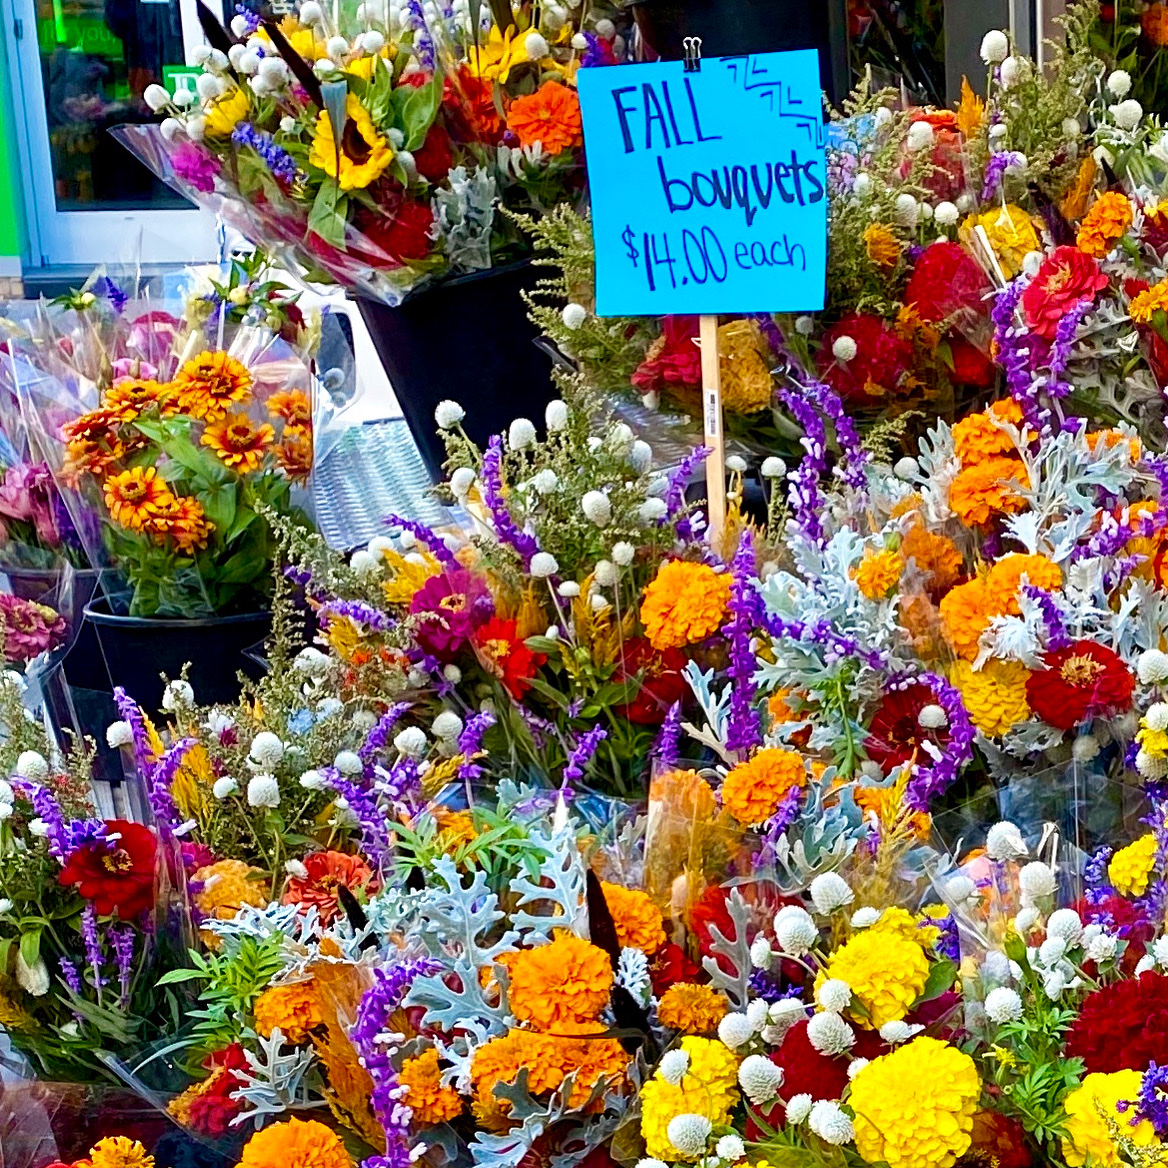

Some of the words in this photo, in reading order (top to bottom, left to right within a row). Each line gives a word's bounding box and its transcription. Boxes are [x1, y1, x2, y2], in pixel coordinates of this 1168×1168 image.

[611, 78, 722, 153] FALL
[657, 150, 825, 227] bouquets
[622, 224, 727, 291] $14.00
[735, 234, 805, 271] each
